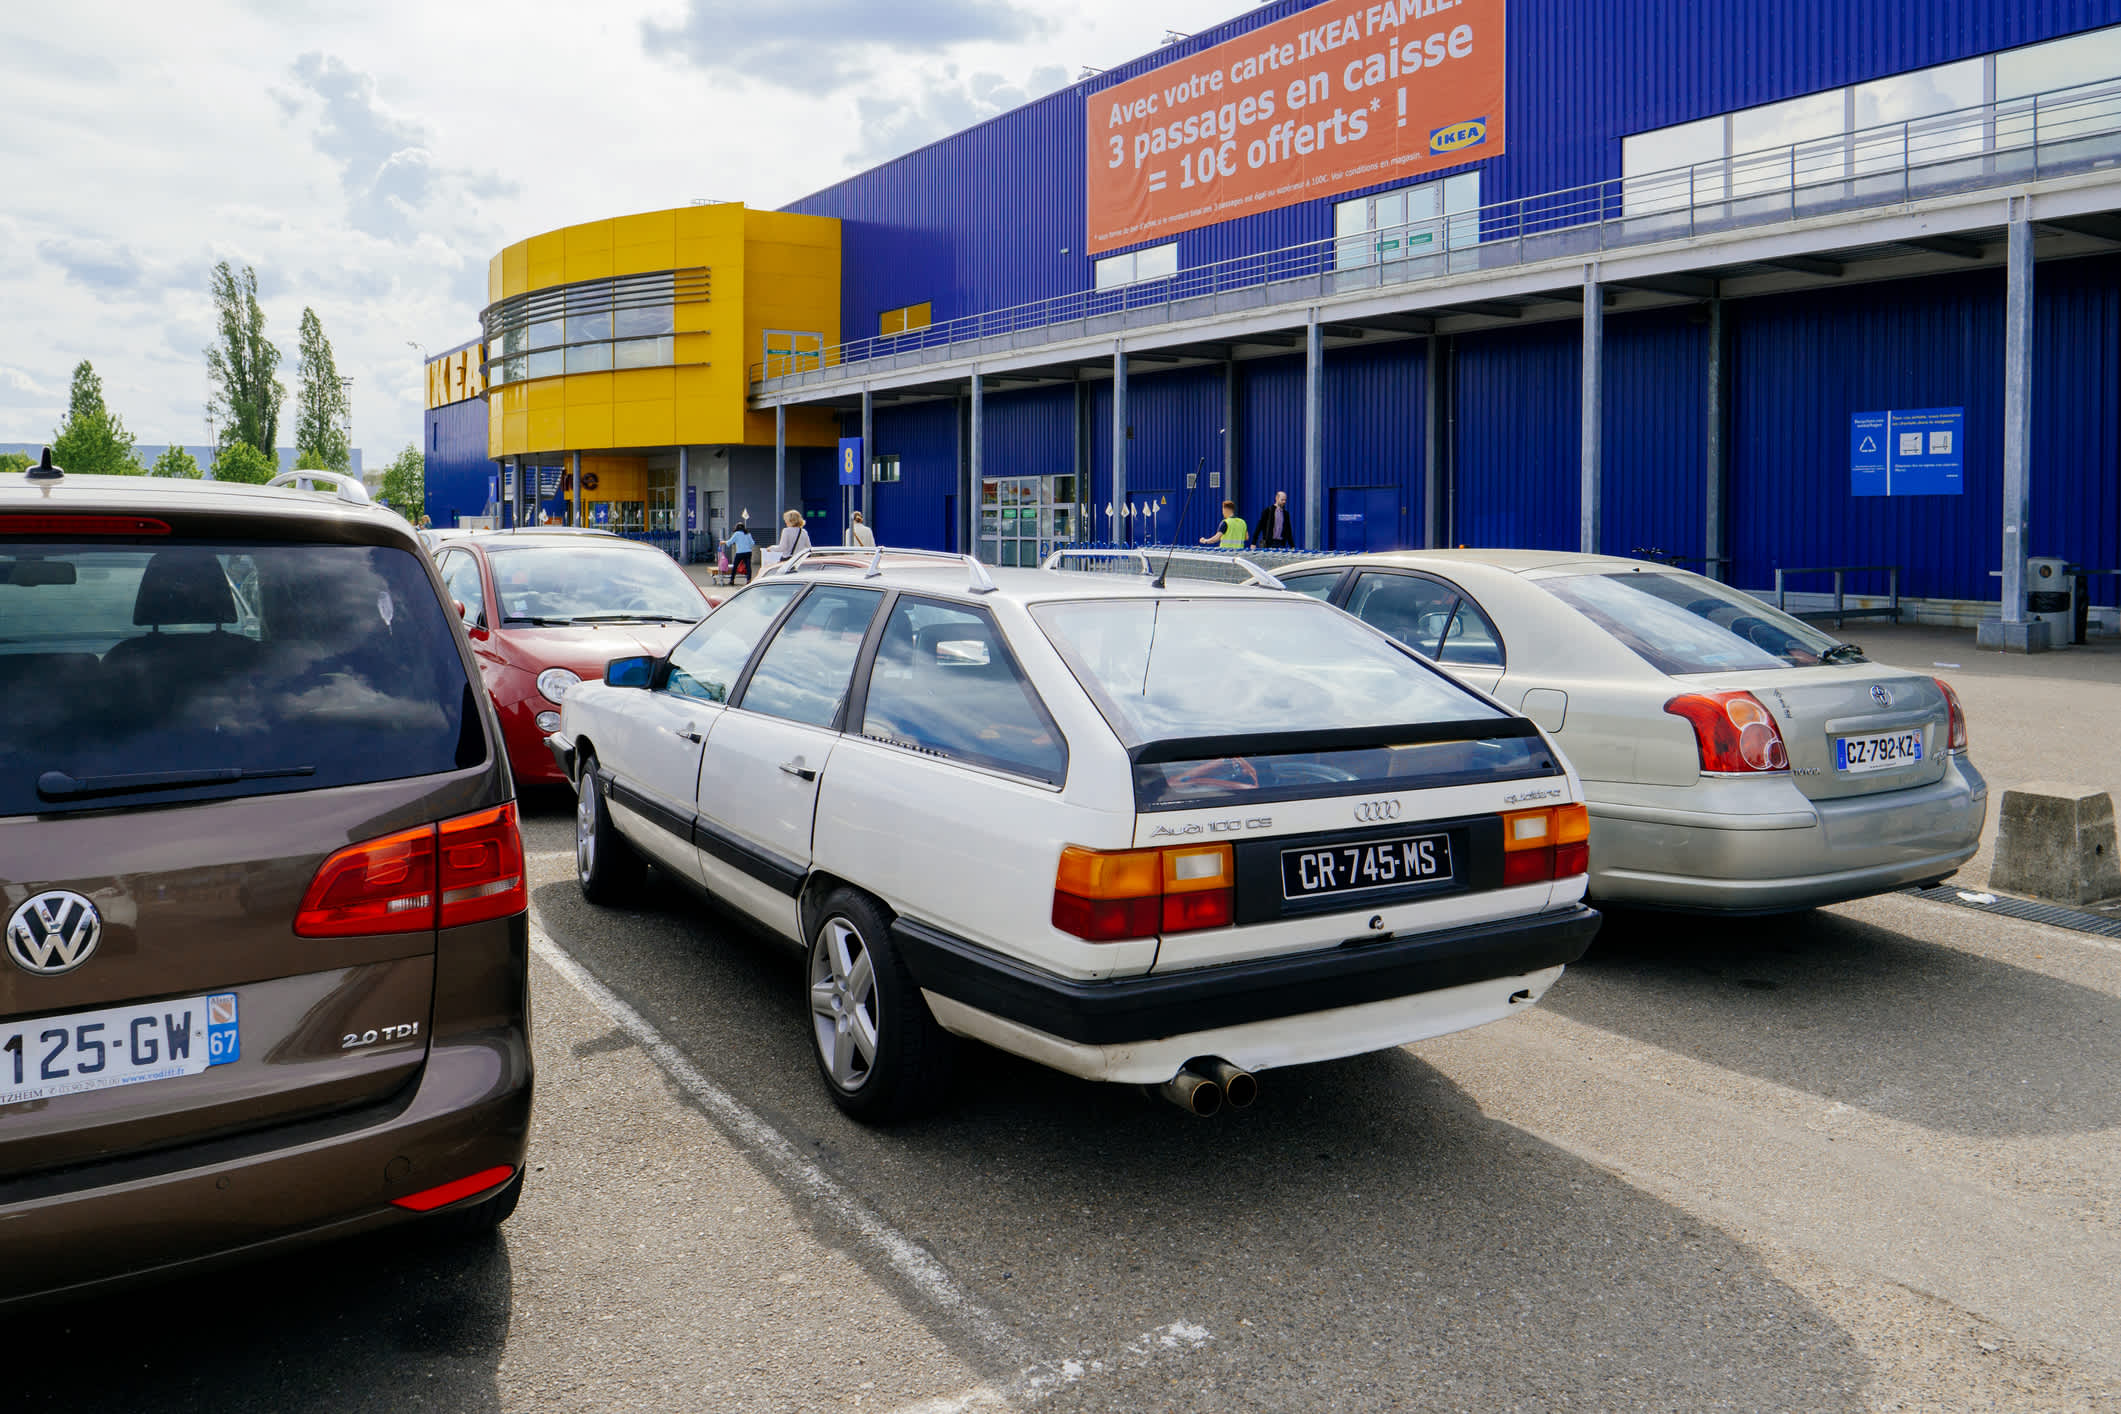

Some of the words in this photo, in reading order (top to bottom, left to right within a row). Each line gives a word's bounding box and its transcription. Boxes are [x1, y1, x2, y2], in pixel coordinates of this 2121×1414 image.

[1109, 93, 1158, 128] Avec
[1164, 69, 1223, 108] votre
[1231, 43, 1294, 83] carte
[1109, 134, 1124, 168] 3
[1135, 89, 1275, 168] passages
[1287, 71, 1328, 110] en
[1344, 24, 1473, 92] caisse
[1437, 126, 1480, 146] IKEA
[1180, 140, 1237, 189] 10€
[424, 344, 484, 409] IKEA
[844, 447, 854, 473] 8
[1846, 735, 1914, 764] CZ-792-KZ
[1207, 818, 1242, 832] 100
[1300, 840, 1436, 890] CR-745-MS
[3, 1011, 192, 1085] 125-GW
[210, 1029, 237, 1056] 67
[381, 1021, 419, 1042] TDI
